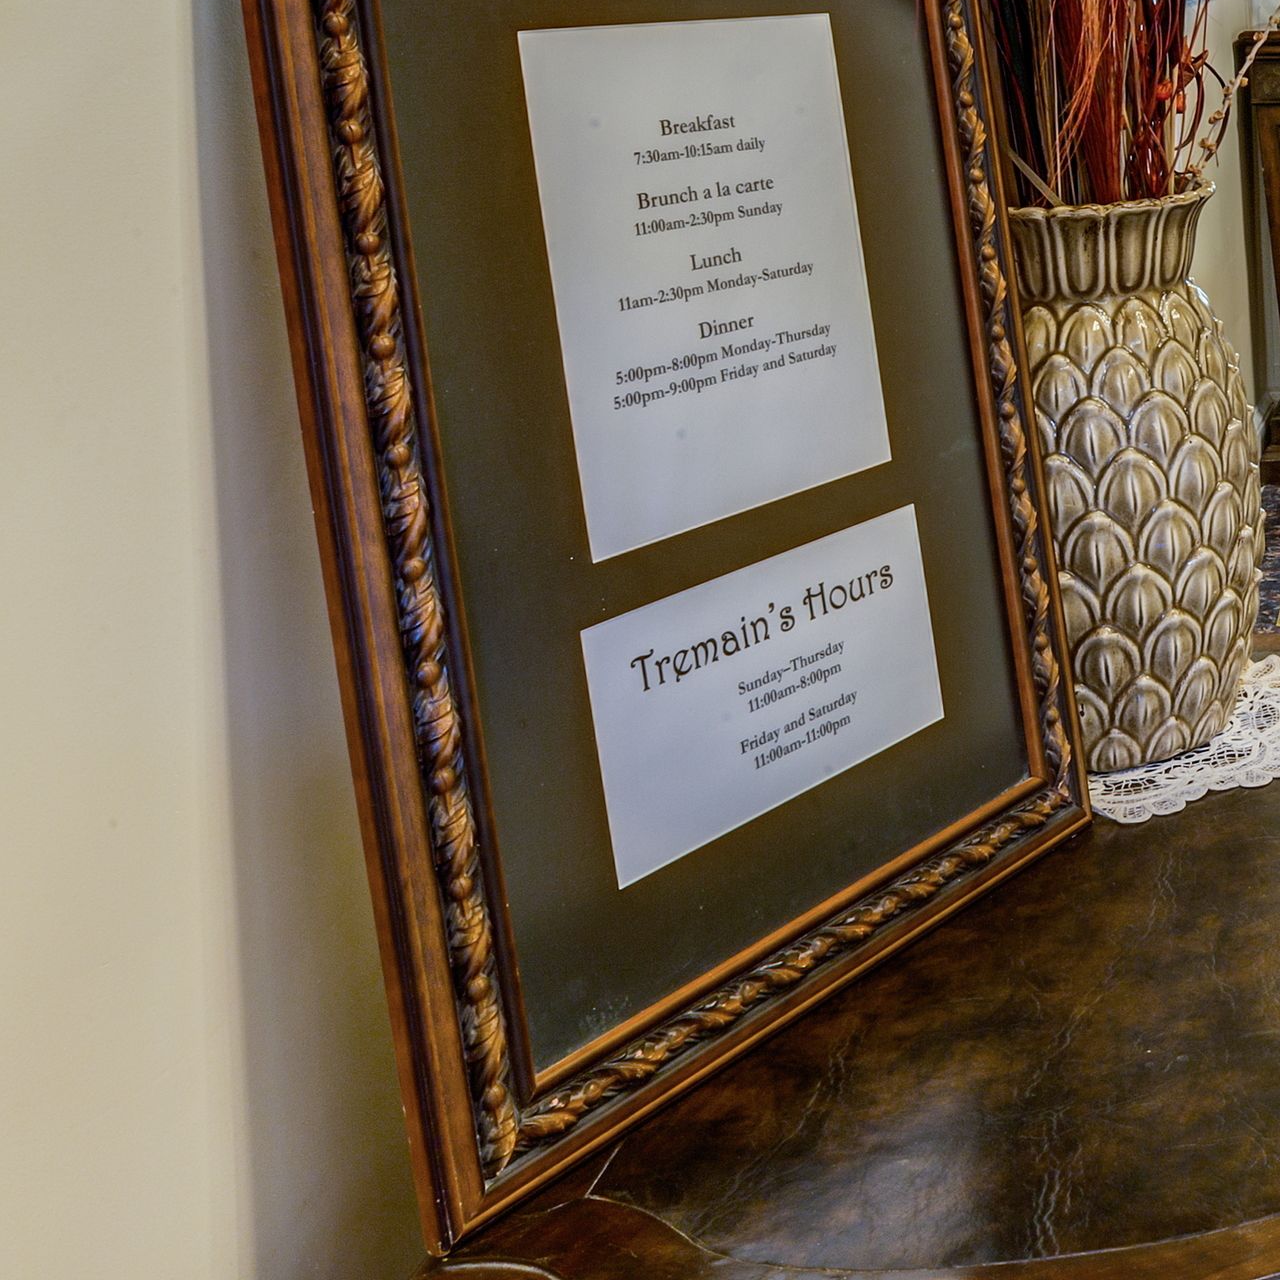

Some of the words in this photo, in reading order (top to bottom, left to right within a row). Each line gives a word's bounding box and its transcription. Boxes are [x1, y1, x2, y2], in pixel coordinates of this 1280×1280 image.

[659, 114, 736, 136] Breakfast
[633, 142, 733, 165] 7:30am-10:15am
[736, 137, 766, 152] daily
[634, 209, 735, 236] 11:00am-2:30pm
[737, 201, 783, 218] Sunday
[637, 185, 698, 210] Brunch
[703, 188, 712, 200] a
[716, 182, 731, 197] la
[735, 176, 774, 195] carte
[689, 247, 742, 271] Lunch
[617, 284, 704, 312] 11am-2:30pm
[706, 261, 814, 293] Monday-Saturday
[698, 315, 755, 339] Dinner
[613, 374, 717, 410] 5:00pm-9:00pm
[719, 363, 759, 383] Friday
[762, 355, 786, 372] and
[788, 342, 838, 366] Saturday
[615, 350, 718, 385] 5:00pm-8:00pm
[720, 323, 831, 358] Monday-Thursday
[802, 565, 893, 621] Hours
[747, 662, 842, 713] 11:00am-8:00pm
[739, 726, 781, 755] Friday
[783, 714, 806, 734] and
[808, 689, 858, 721] Saturday
[754, 714, 851, 770] 11:00am-11:00pm
